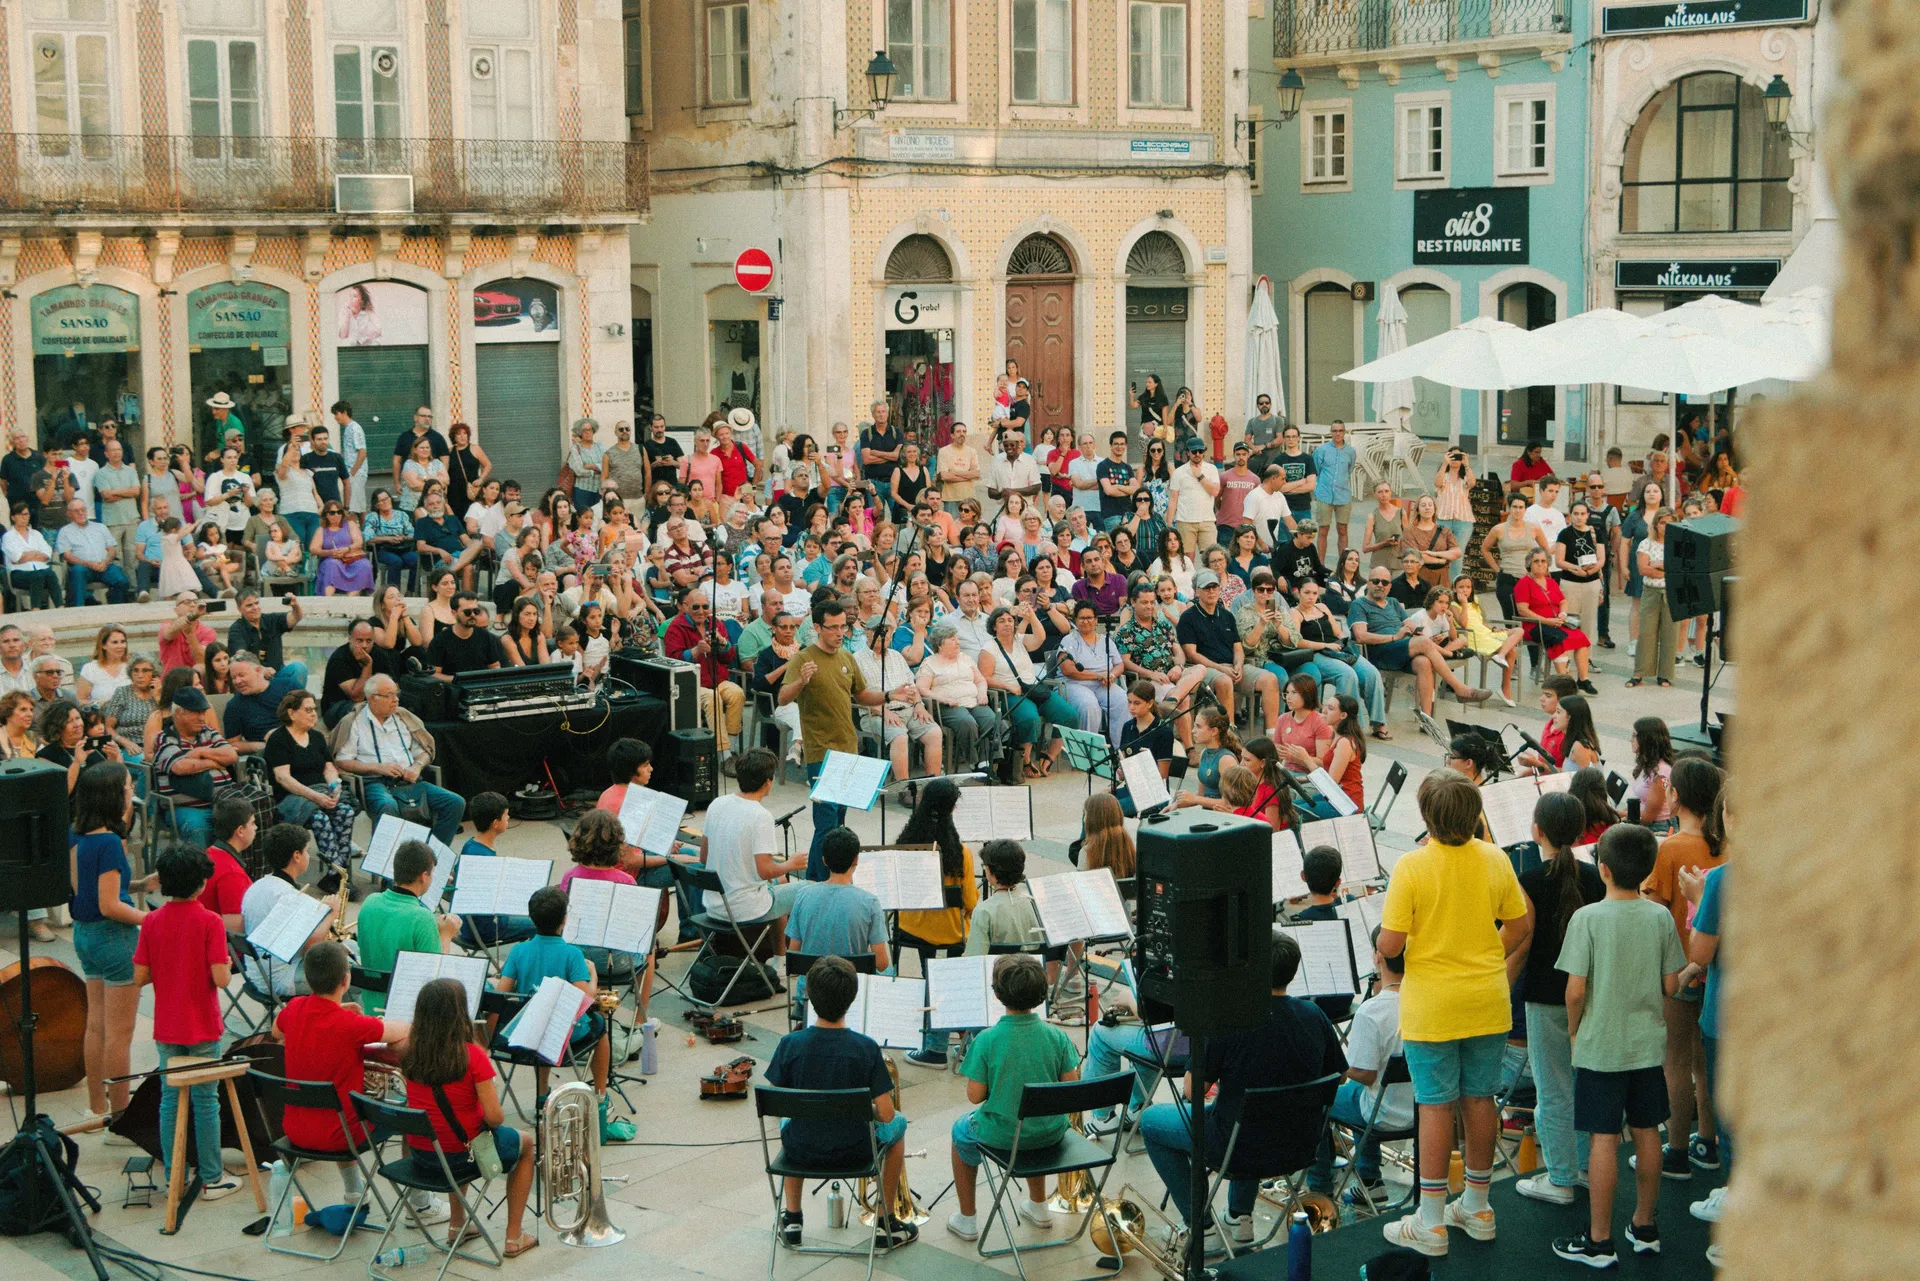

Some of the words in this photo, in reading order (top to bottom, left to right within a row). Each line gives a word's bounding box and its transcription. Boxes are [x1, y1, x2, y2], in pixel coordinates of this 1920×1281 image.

[1664, 3, 1736, 27] NICKOLAUS
[1417, 238, 1522, 253] RESTAURANTE
[1657, 262, 1732, 286] NICKOLAUS
[40, 299, 86, 318] TAMANHOS
[89, 299, 128, 316] GRANDES
[195, 291, 238, 309] TAMANHOS
[241, 291, 278, 309] GRANDES
[1226, 481, 1256, 490] DISTORT
